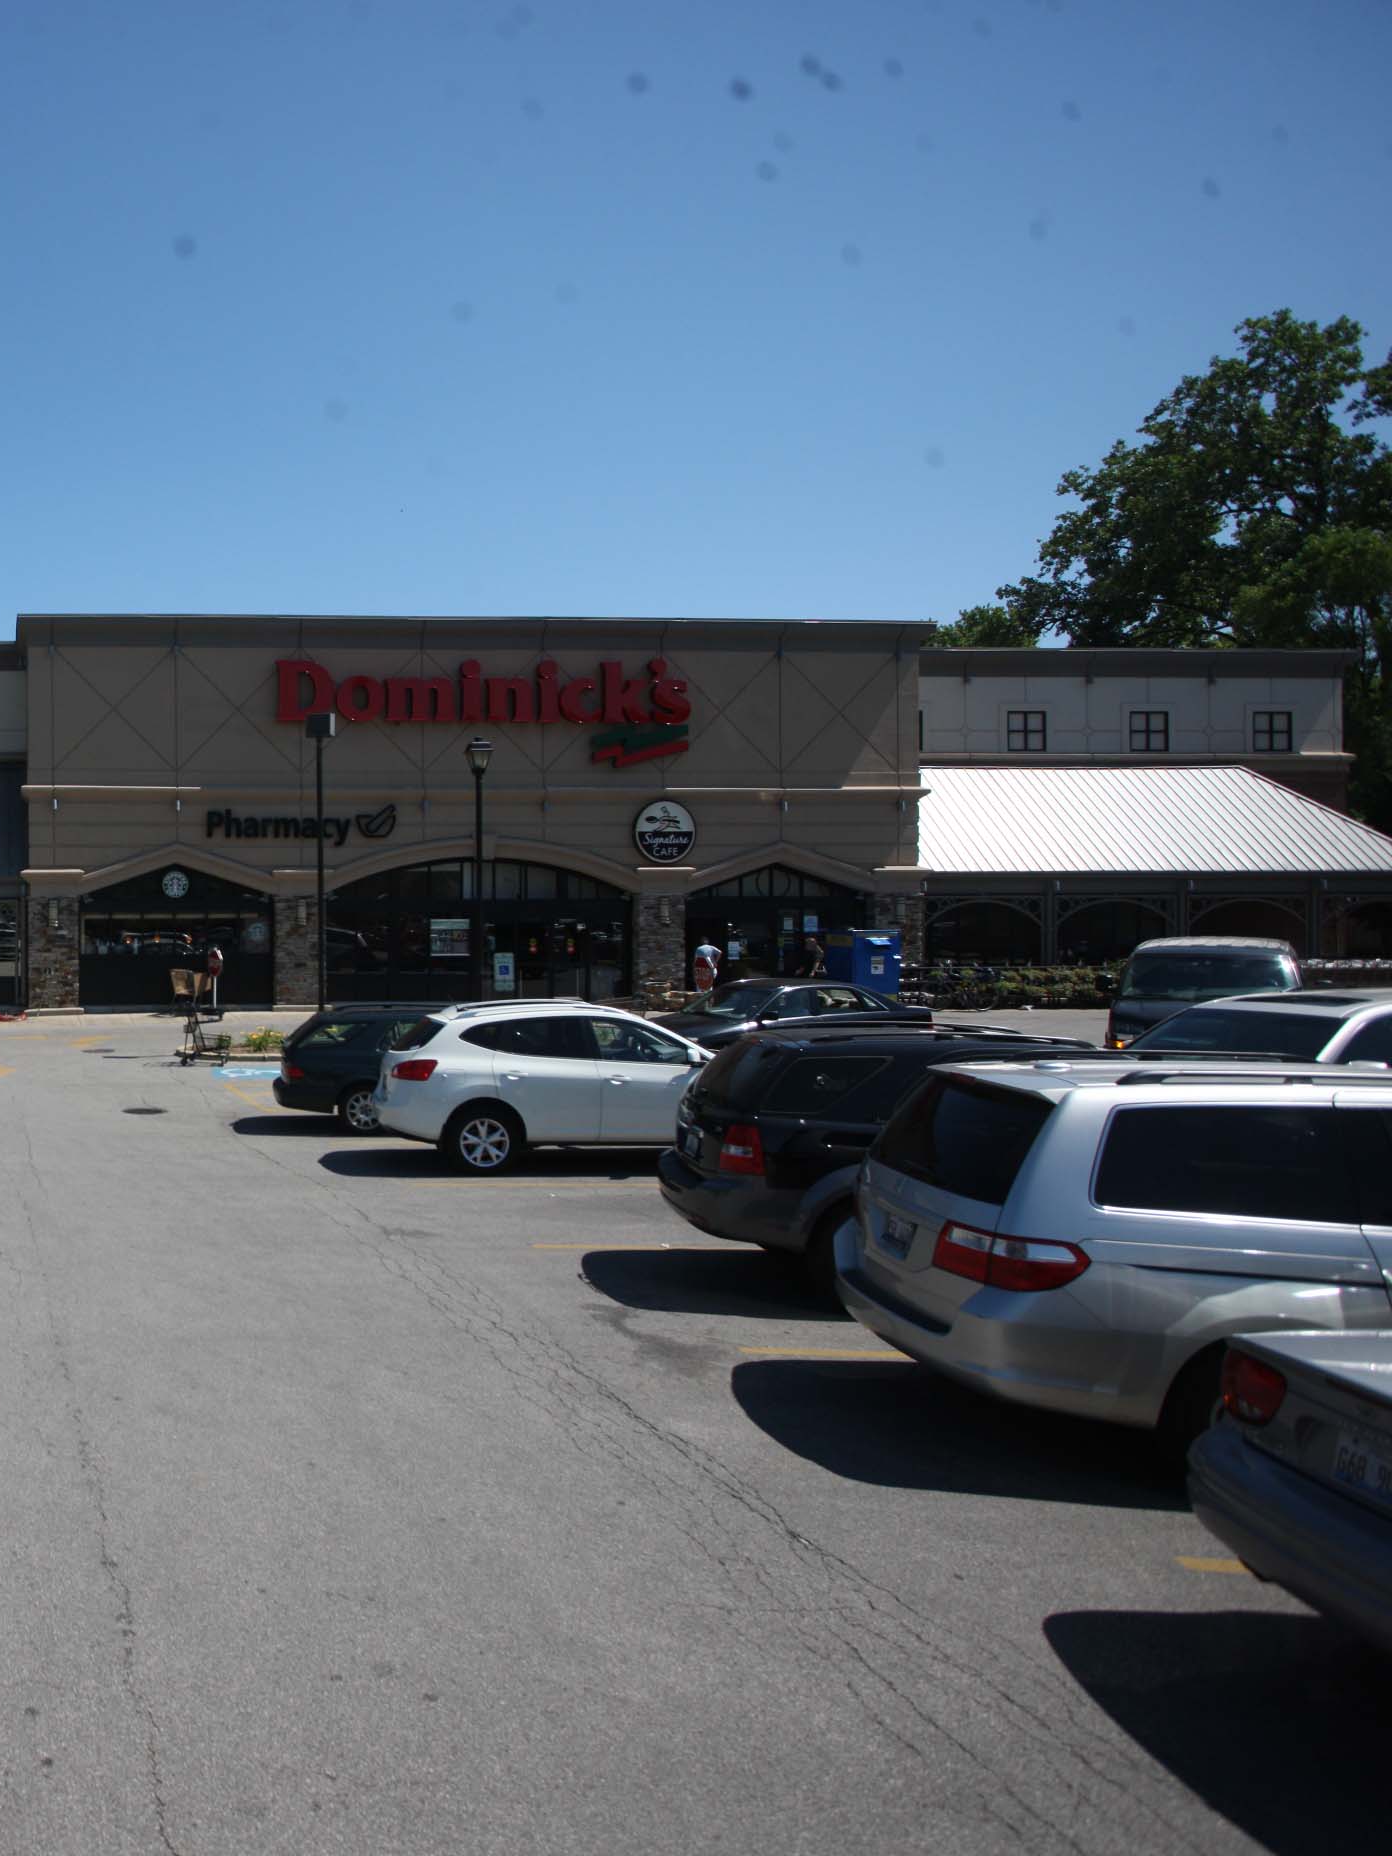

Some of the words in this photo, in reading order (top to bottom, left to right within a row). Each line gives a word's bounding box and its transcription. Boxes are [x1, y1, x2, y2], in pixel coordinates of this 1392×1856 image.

[275, 657, 691, 725] Dominick's
[206, 809, 350, 847] Pharmacy
[643, 833, 689, 847] Signature
[653, 847, 679, 856] CAFE
